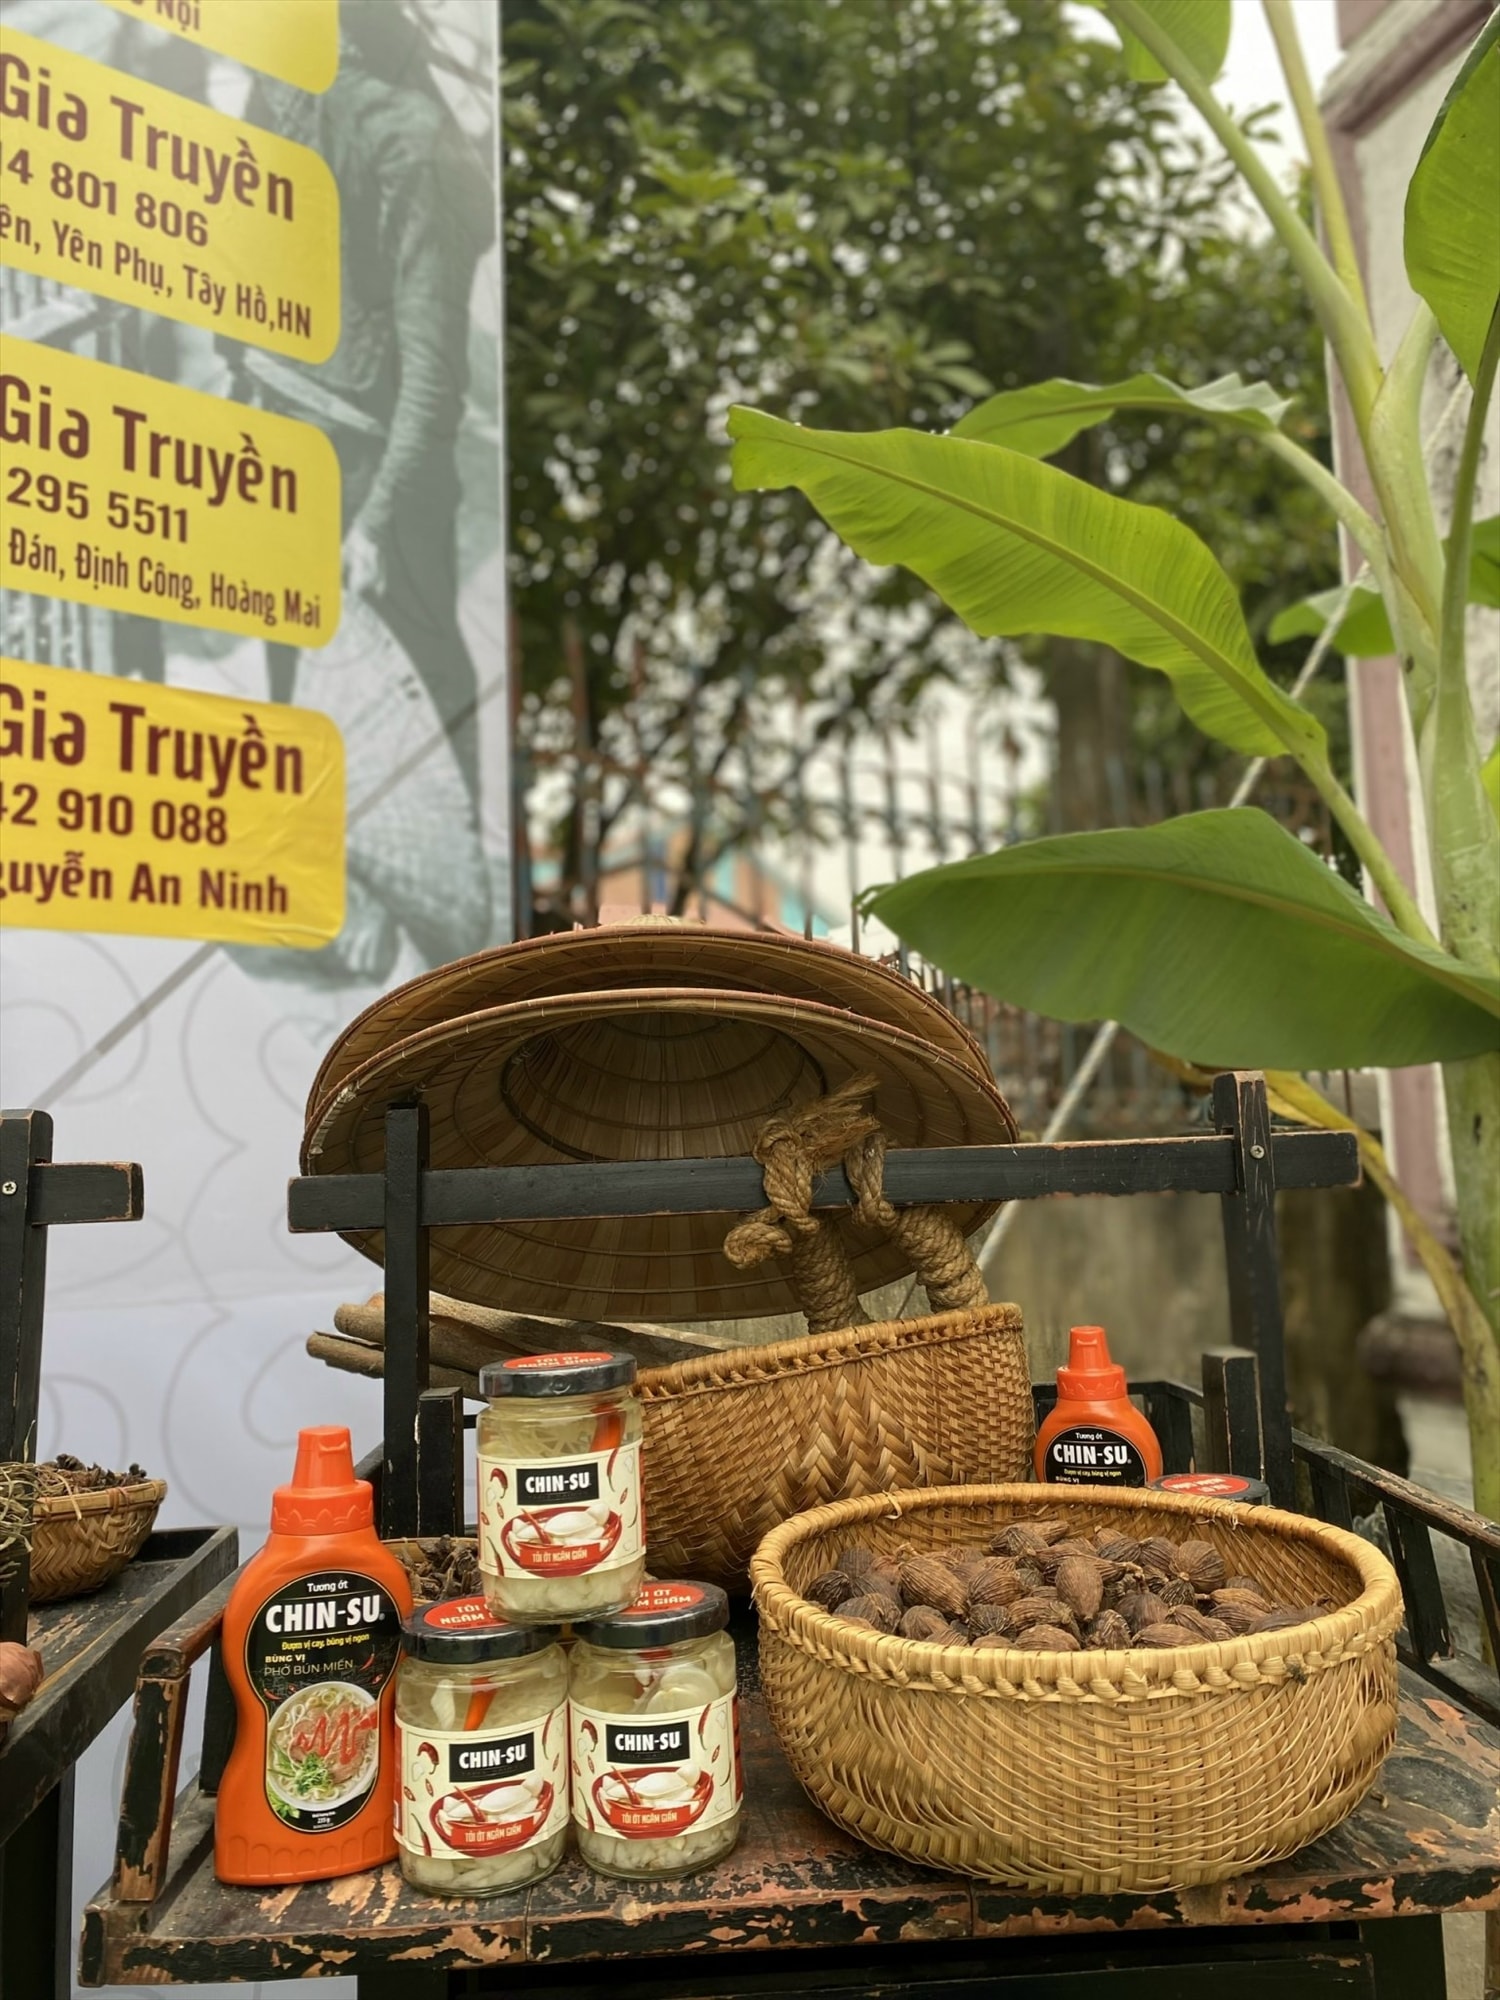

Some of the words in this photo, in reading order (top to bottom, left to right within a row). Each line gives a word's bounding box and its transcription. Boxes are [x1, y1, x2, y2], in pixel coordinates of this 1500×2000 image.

[0, 53, 88, 142] Gia
[110, 95, 294, 222] Truyền
[50, 161, 117, 216] 801
[135, 192, 209, 247] 806
[52, 218, 102, 270] Yên
[115, 240, 173, 298] Phụ,
[183, 264, 227, 316] Tây
[0, 374, 90, 460] Gia
[113, 405, 297, 514] Truyền
[6, 467, 89, 520] 295
[108, 491, 188, 543] 5511
[8, 528, 66, 581] Đán,
[75, 543, 129, 590] Định
[138, 556, 201, 610] Công,
[211, 572, 277, 626] Hoàng
[284, 588, 320, 628] Mai
[0, 683, 85, 766] Gia
[109, 702, 303, 799] Truyền
[58, 788, 133, 837] 910
[152, 800, 228, 846] 088
[130, 863, 181, 906] An
[200, 869, 288, 915] Ninh
[525, 1472, 590, 1493] CHIN-SU
[1053, 1444, 1128, 1465] CHIN-SU
[265, 1594, 380, 1633] CHIN-SU
[307, 1582, 336, 1593] Tương
[458, 1743, 526, 1769] CHIN-SU
[614, 1731, 681, 1751] CHIN-SU
